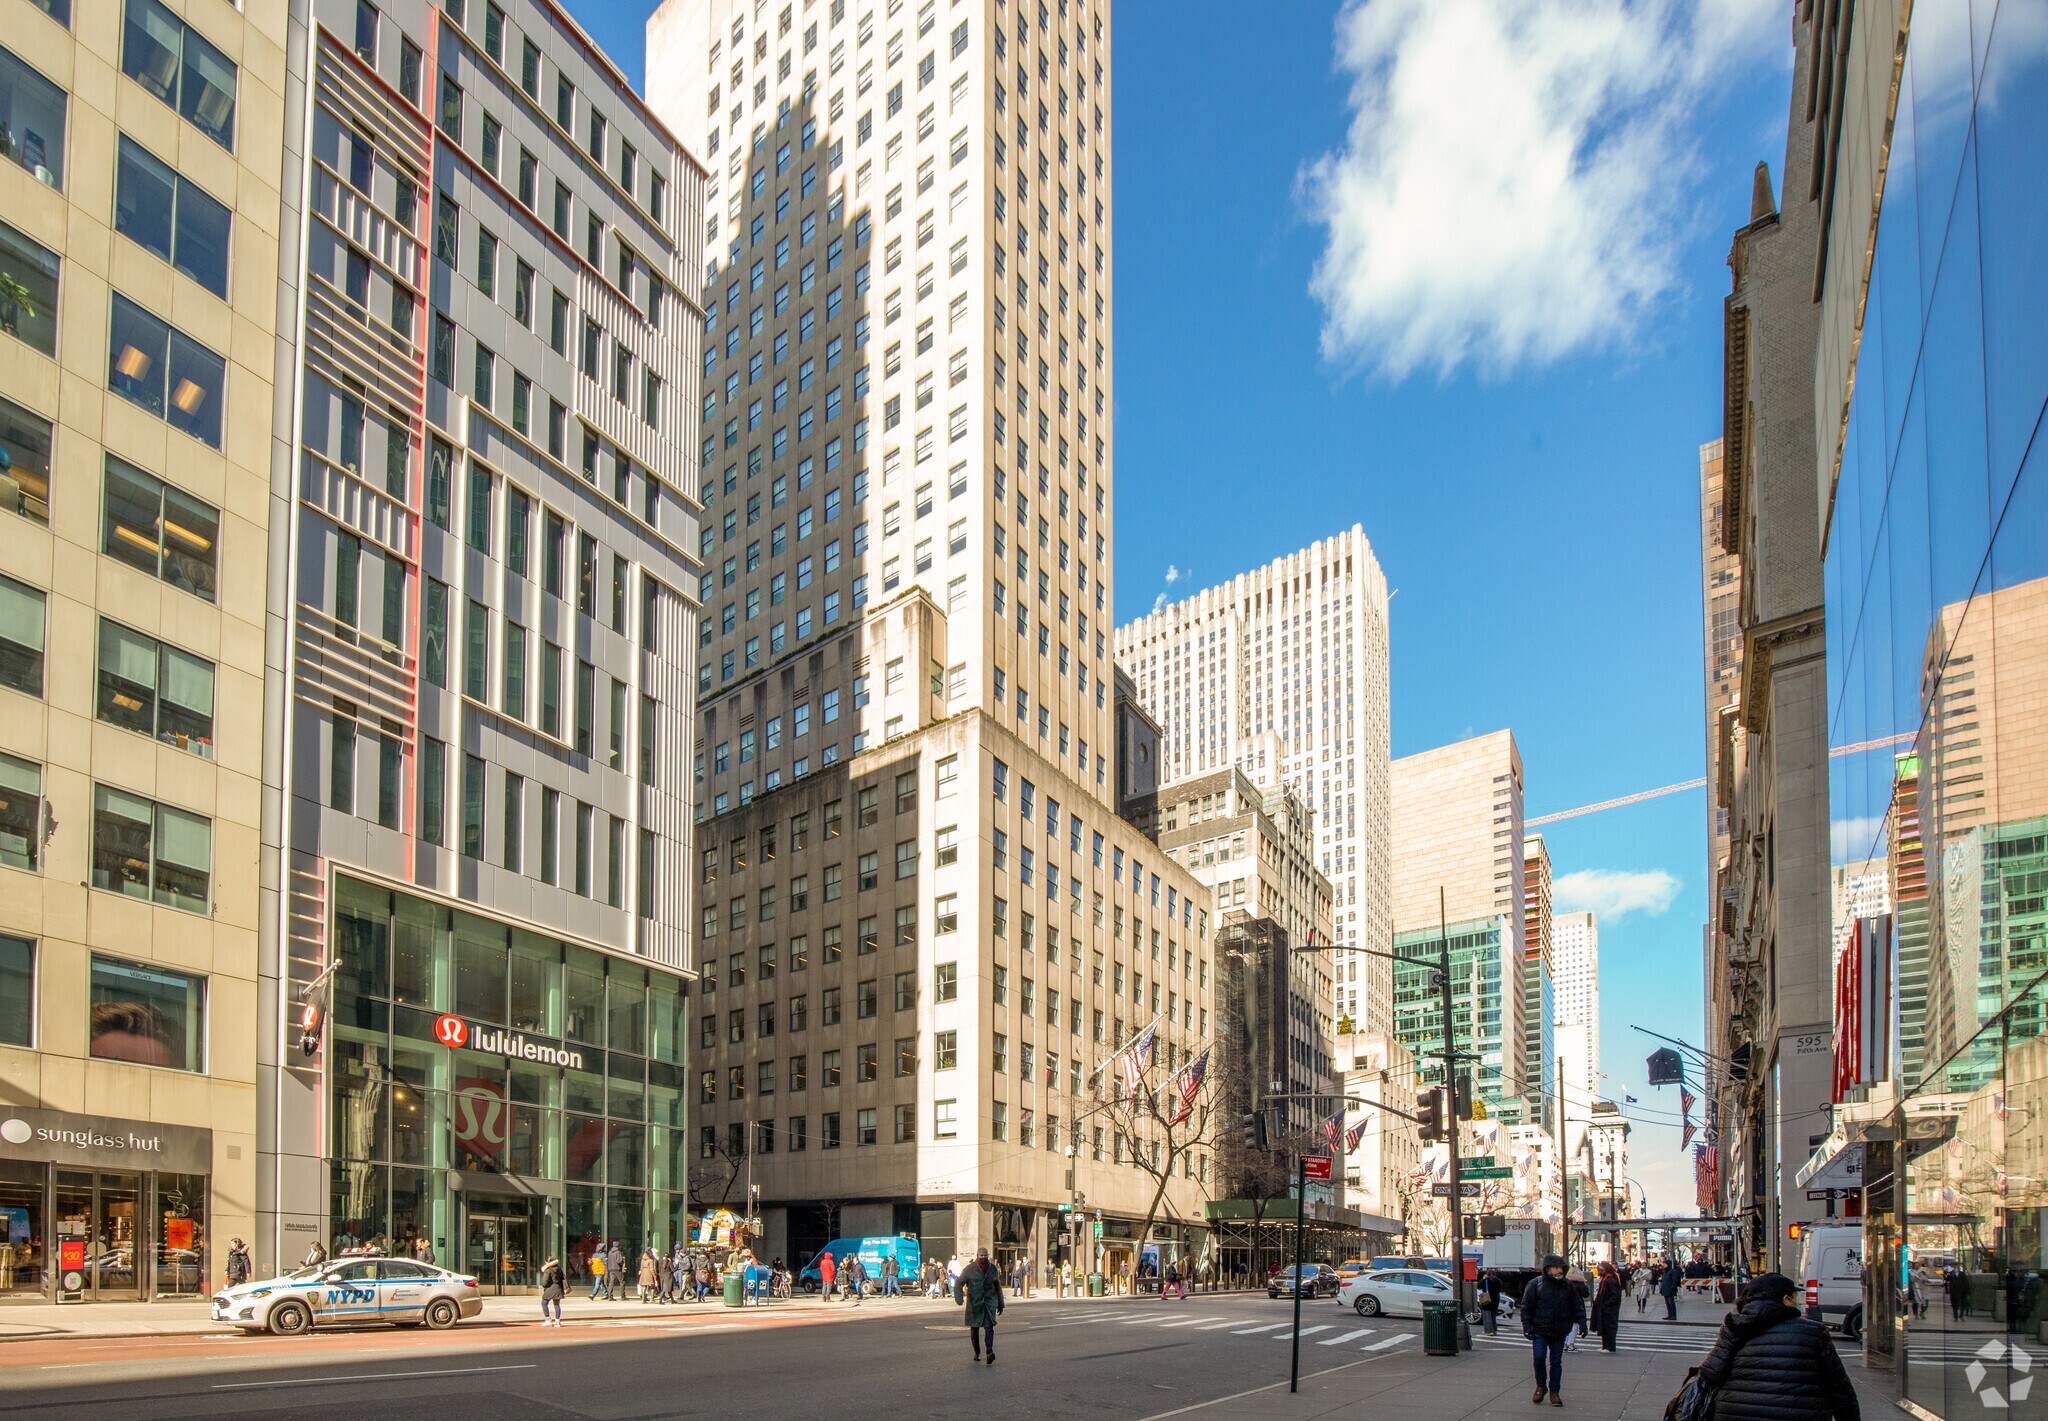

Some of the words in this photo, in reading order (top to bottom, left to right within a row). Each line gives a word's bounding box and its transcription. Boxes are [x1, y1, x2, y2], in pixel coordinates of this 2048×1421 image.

[475, 1025, 582, 1069] lululemon
[1797, 1036, 1821, 1047] 595
[37, 1127, 125, 1149] sunglass
[129, 1133, 161, 1152] hut
[1476, 1158, 1486, 1167] 48
[1485, 1168, 1510, 1176] Goldberg
[1505, 1221, 1531, 1232] greko
[64, 1251, 80, 1261] $30
[325, 1289, 375, 1305] NYPD
